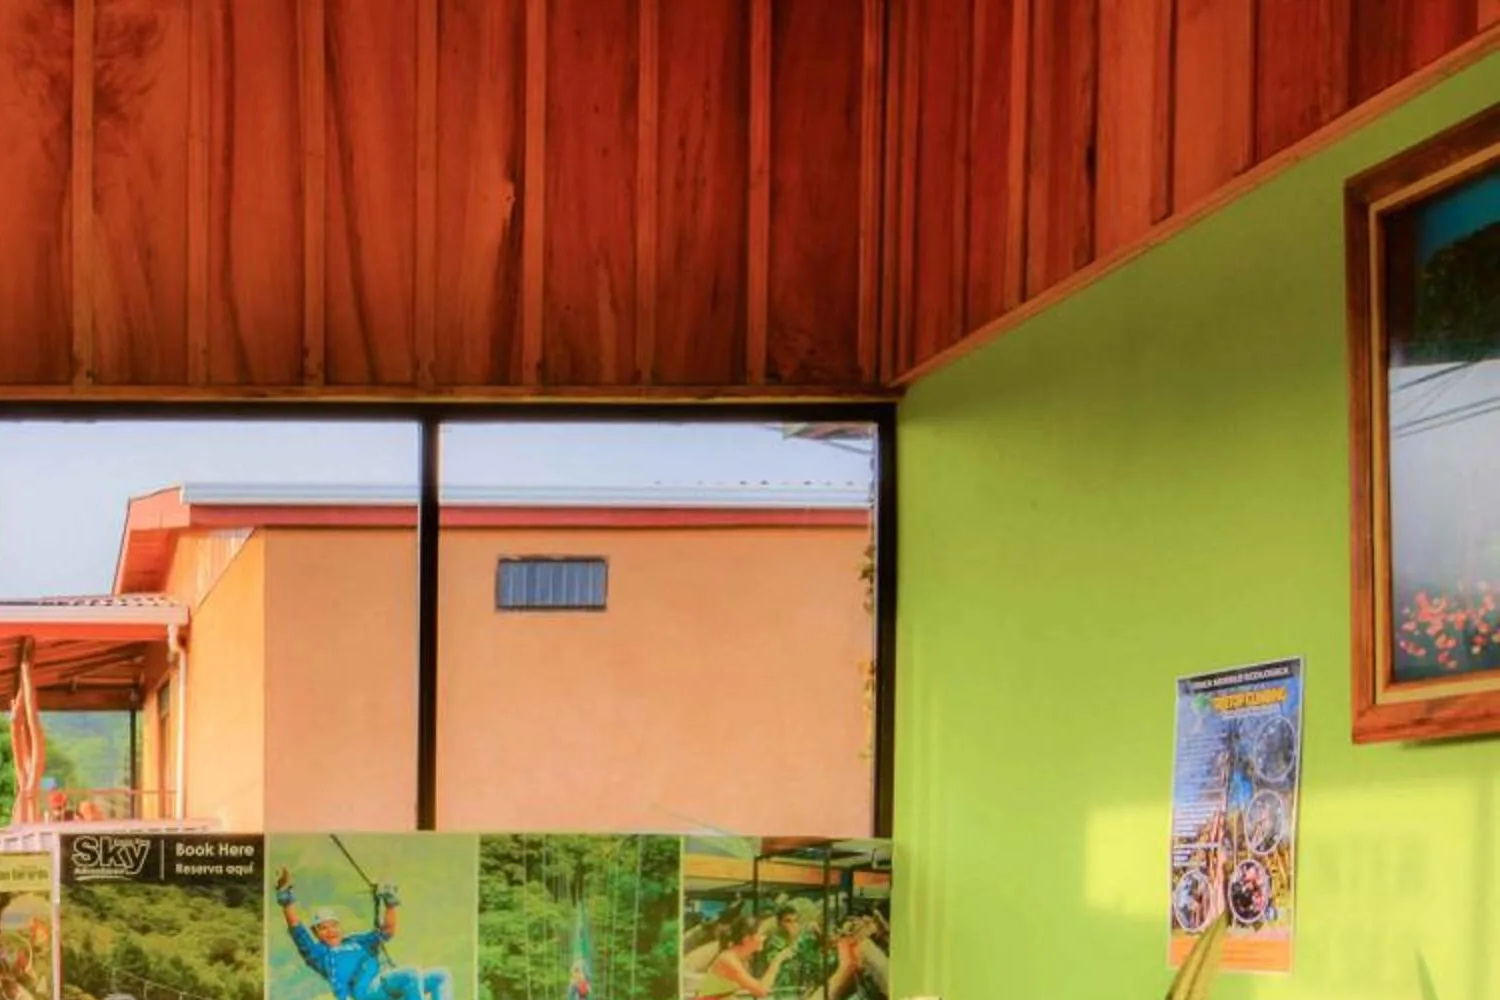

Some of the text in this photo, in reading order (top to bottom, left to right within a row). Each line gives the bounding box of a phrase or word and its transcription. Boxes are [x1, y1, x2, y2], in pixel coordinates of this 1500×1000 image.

[72, 835, 151, 875] Sky
[176, 843, 255, 857] Book Here
[176, 863, 223, 875] Reserva
